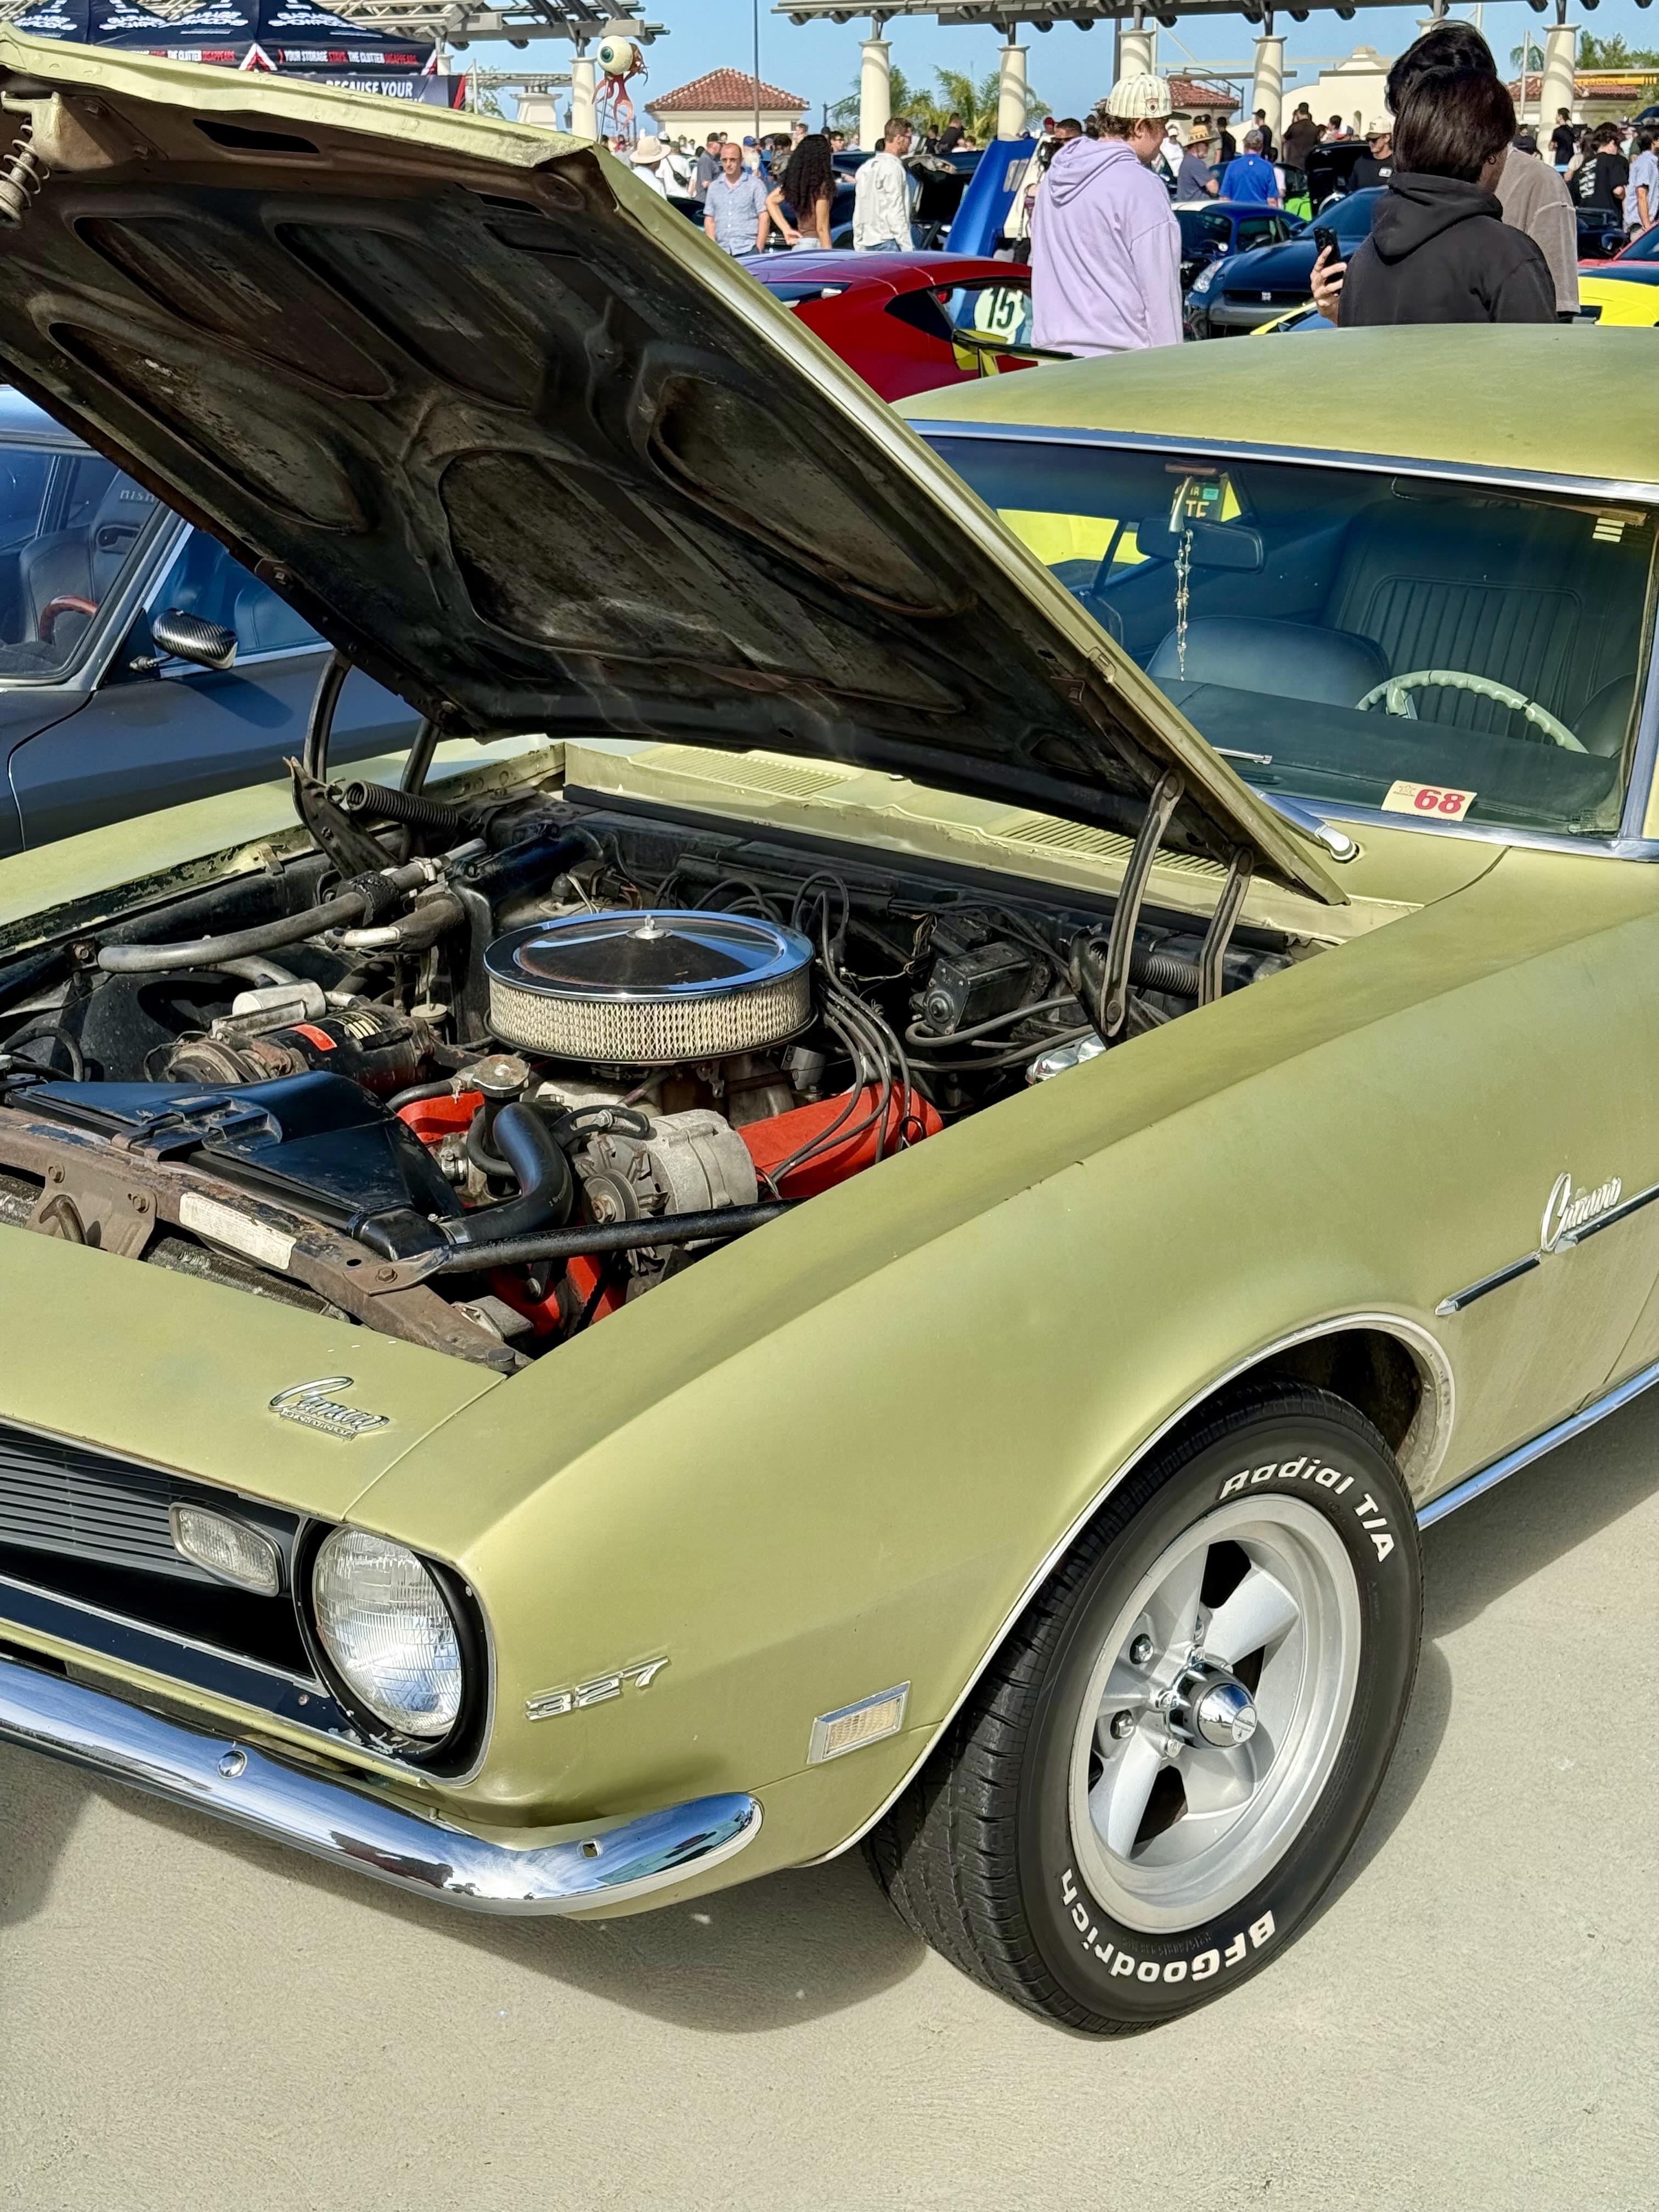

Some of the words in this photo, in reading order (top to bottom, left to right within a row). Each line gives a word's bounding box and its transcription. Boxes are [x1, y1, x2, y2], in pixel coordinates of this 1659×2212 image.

[381, 82, 414, 98] YOUR
[988, 287, 1015, 329] 15
[1414, 789, 1466, 814] 68
[1541, 1172, 1622, 1252] Camaro
[267, 1376, 390, 1434] Camaro
[1218, 1455, 1355, 1500] Radial
[1353, 1493, 1395, 1562] T/A
[525, 1655, 669, 1721] 327
[1061, 1867, 1276, 1984] BFGoodrich
